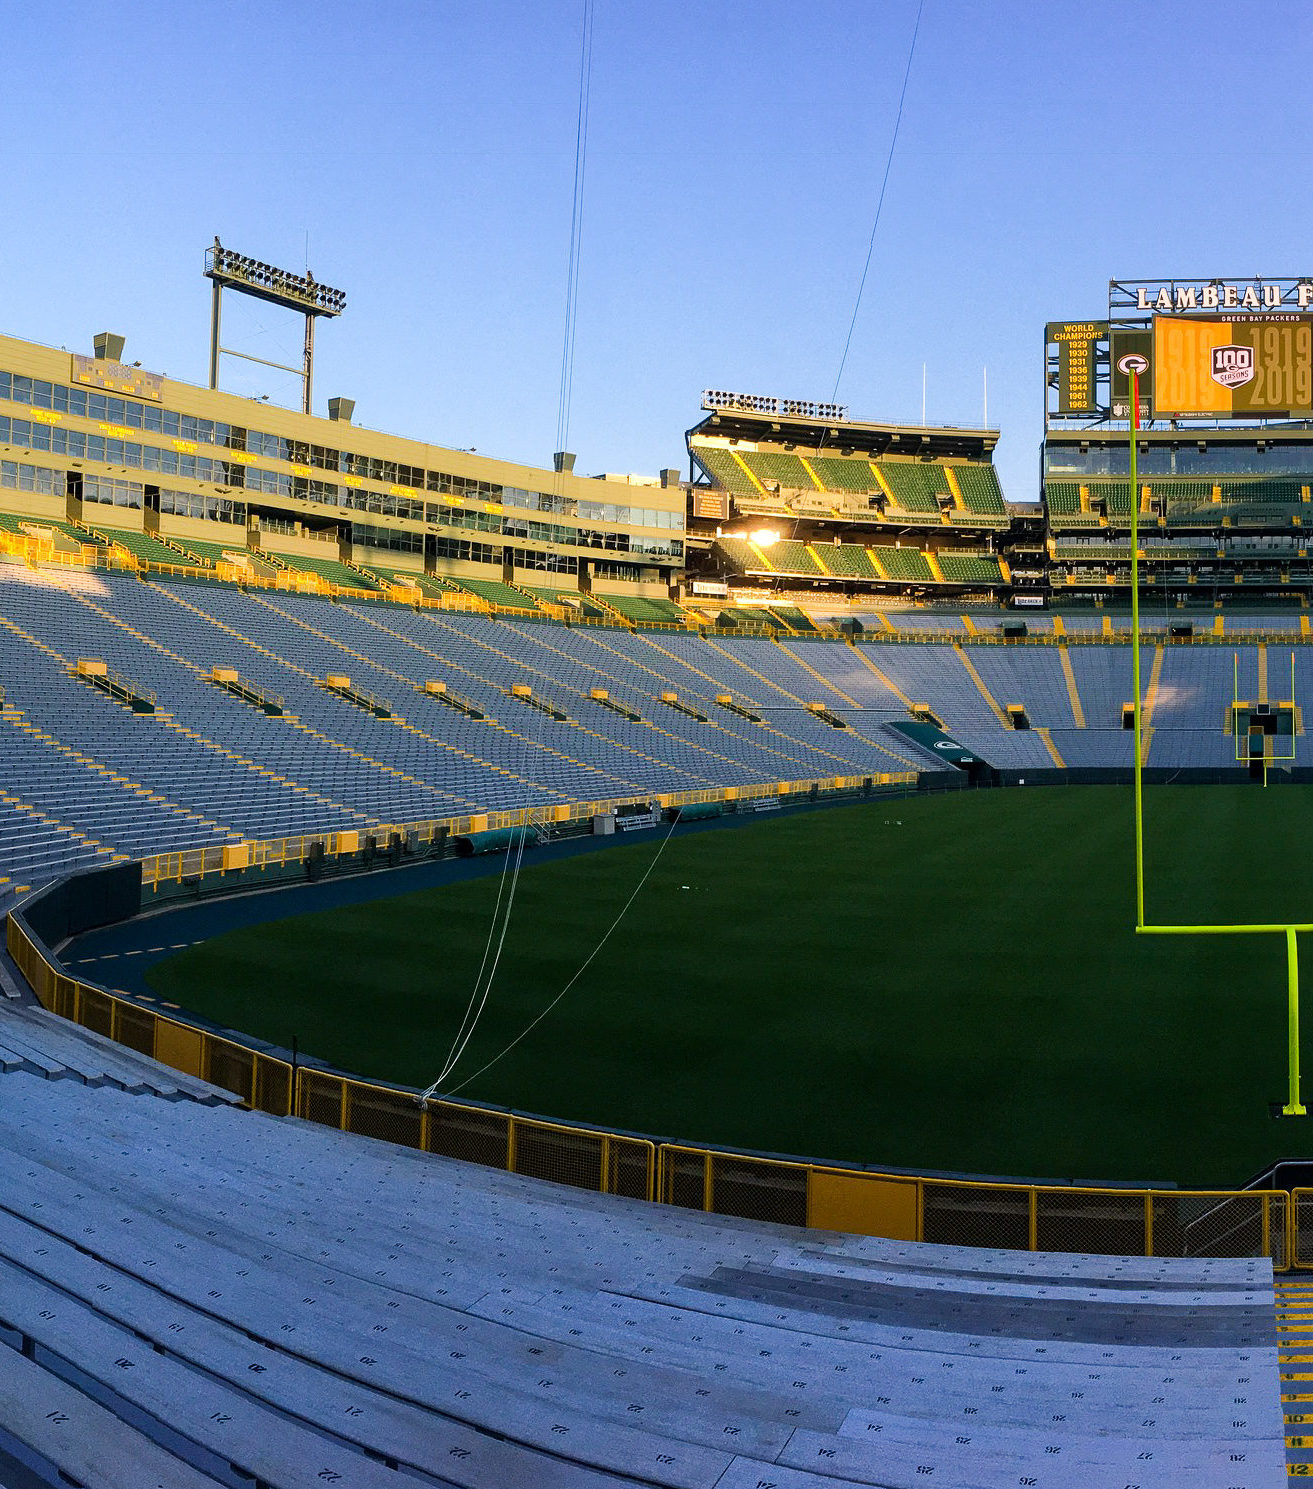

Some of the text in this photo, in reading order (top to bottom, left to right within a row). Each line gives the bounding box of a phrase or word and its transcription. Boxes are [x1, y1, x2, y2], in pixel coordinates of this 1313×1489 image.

[1137, 286, 1282, 309] LAMBEAU
[1054, 332, 1103, 341] CHAMPIONS
[1249, 327, 1311, 367] 1919
[1069, 358, 1086, 366] 1931
[1216, 351, 1249, 368] 100
[1069, 375, 1088, 383] 1939
[1220, 370, 1249, 382] SEASONS
[1249, 365, 1311, 405] 2019
[1069, 392, 1086, 400] 1961
[1069, 401, 1088, 409] 1962
[38, 1310, 57, 1321] 19
[449, 1351, 467, 1360] 20
[114, 1357, 136, 1370] 20
[359, 1356, 378, 1367] 20
[247, 1363, 268, 1374] 20
[454, 1389, 472, 1400] 21
[344, 1405, 364, 1417] 21
[626, 1403, 645, 1414] 22
[45, 1410, 70, 1425] 21
[209, 1412, 232, 1425] 21
[550, 1423, 571, 1435] 22
[723, 1426, 742, 1436] 23
[866, 1423, 884, 1433] 24
[1291, 1437, 1302, 1446] 11
[449, 1446, 472, 1460] 22
[817, 1448, 837, 1459] 24
[1044, 1445, 1062, 1455] 26
[655, 1454, 676, 1465] 23
[1136, 1452, 1154, 1461] 27
[317, 1467, 343, 1484] 22
[915, 1465, 935, 1476] 25
[1291, 1465, 1309, 1475] 12
[755, 1480, 778, 1489] 24
[1018, 1476, 1038, 1487] 26
